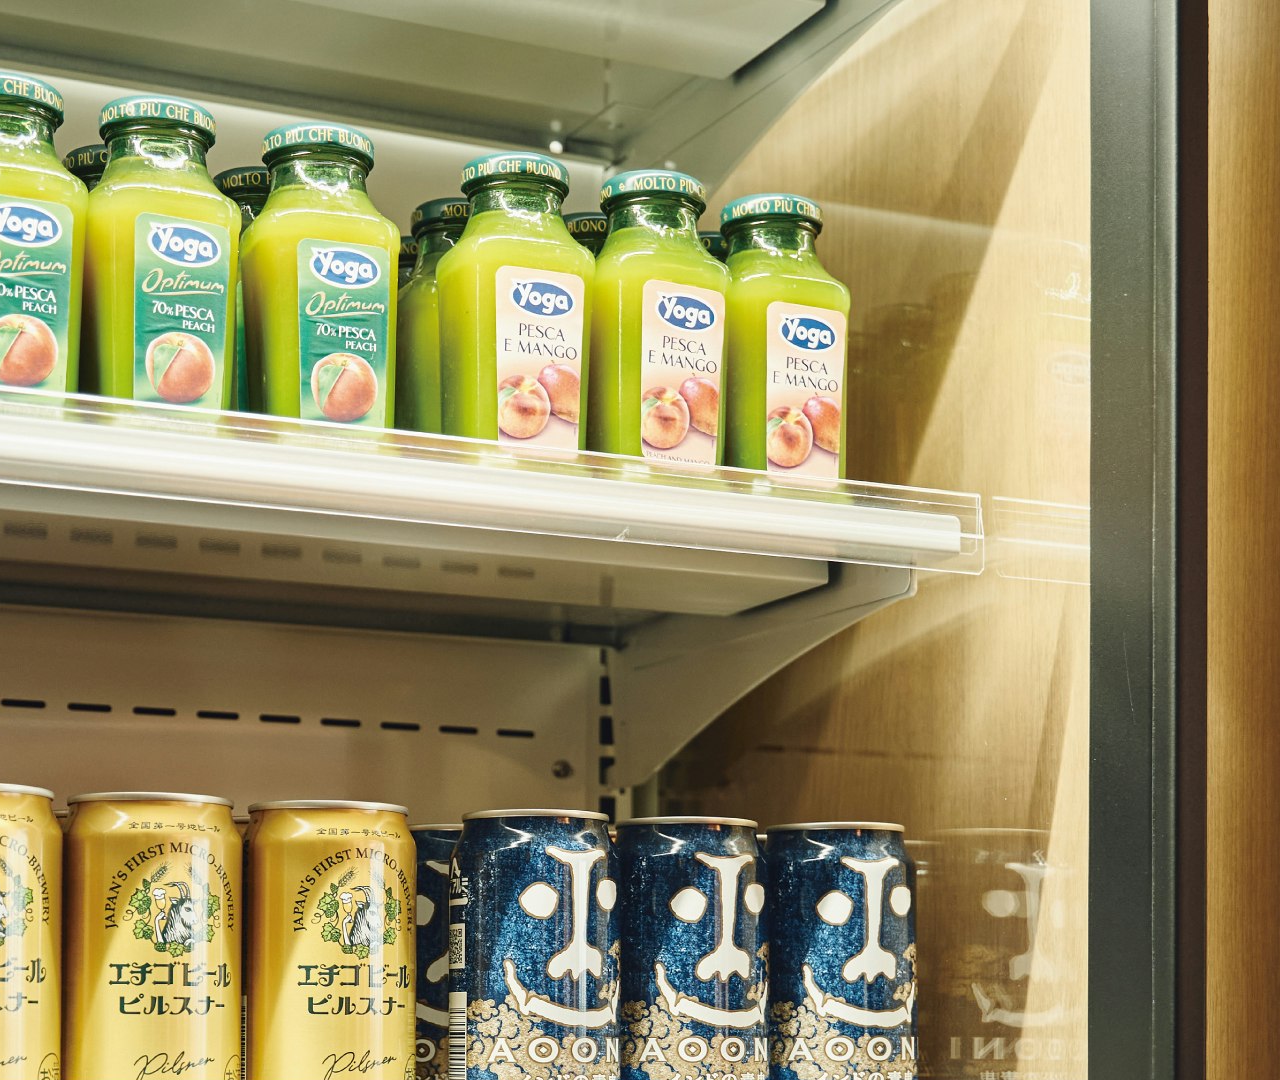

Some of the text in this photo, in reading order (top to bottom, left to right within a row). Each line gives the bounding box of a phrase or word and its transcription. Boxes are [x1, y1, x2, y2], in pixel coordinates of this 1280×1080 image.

[4, 81, 29, 93] CHE
[139, 100, 161, 116] PIÙ
[309, 128, 333, 141] CHE
[526, 161, 561, 180] BUONO
[222, 173, 262, 188] MOLTO
[142, 268, 224, 293] Optimum
[15, 286, 57, 303] PESCA
[305, 291, 385, 315] Optimum
[23, 301, 57, 314] PEACH
[175, 304, 214, 321] PESCA
[182, 320, 215, 333] PEACH
[338, 325, 376, 341] PESCA
[518, 323, 565, 342] PESCA
[345, 340, 377, 352] PEACH
[504, 339, 577, 360] E MANGO
[662, 335, 707, 355] PESCA
[659, 352, 717, 373] MANGO
[786, 356, 827, 374] PESCA
[785, 373, 838, 392] MANGO
[109, 961, 231, 988] エチゴビール
[298, 963, 410, 989] エチゴビール
[120, 994, 225, 1015] ピルスナー
[308, 995, 405, 1015] ピルスナー
[788, 1036, 918, 1061] AOON
